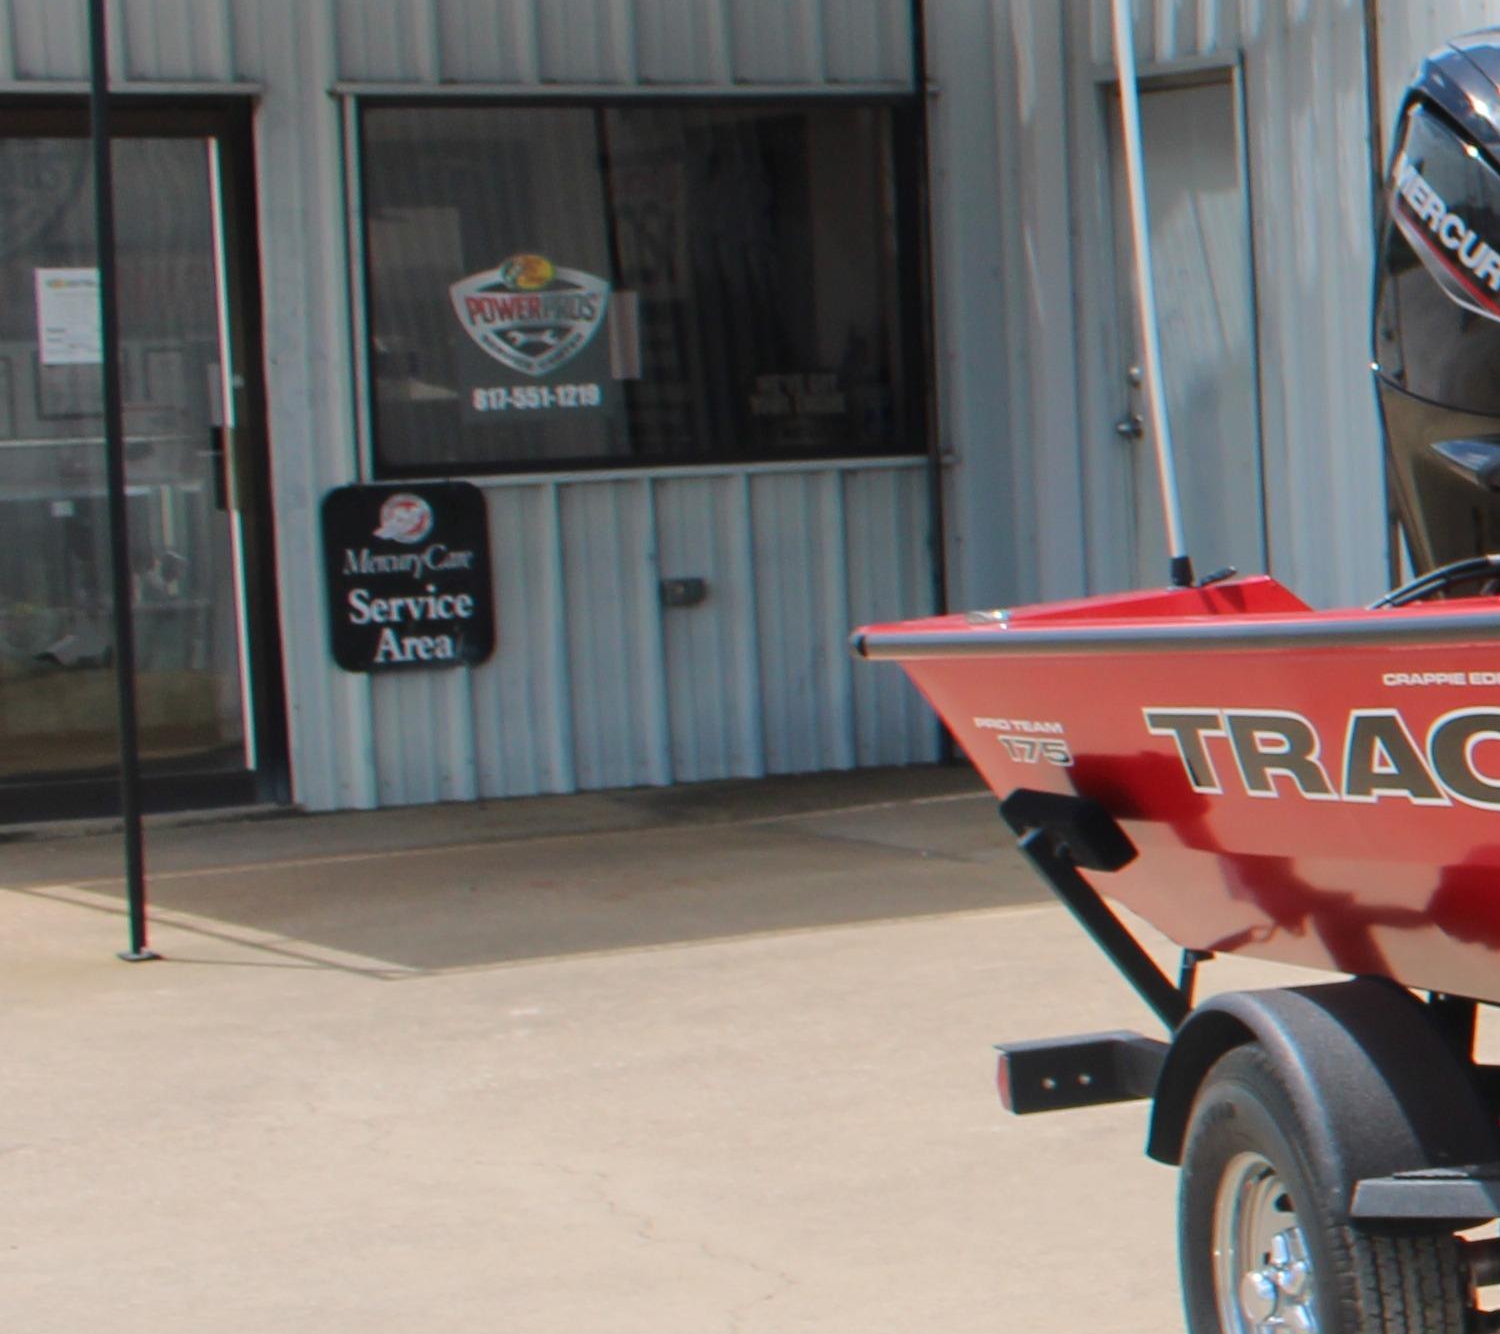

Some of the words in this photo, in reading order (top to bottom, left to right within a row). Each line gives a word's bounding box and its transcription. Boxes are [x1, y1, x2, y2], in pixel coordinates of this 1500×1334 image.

[348, 584, 474, 624] Service
[373, 627, 454, 663] Area
[1382, 672, 1466, 686] CRAPPIE
[973, 717, 1011, 731] PRO
[1010, 719, 1065, 734] TEAM
[997, 734, 1075, 767] 175
